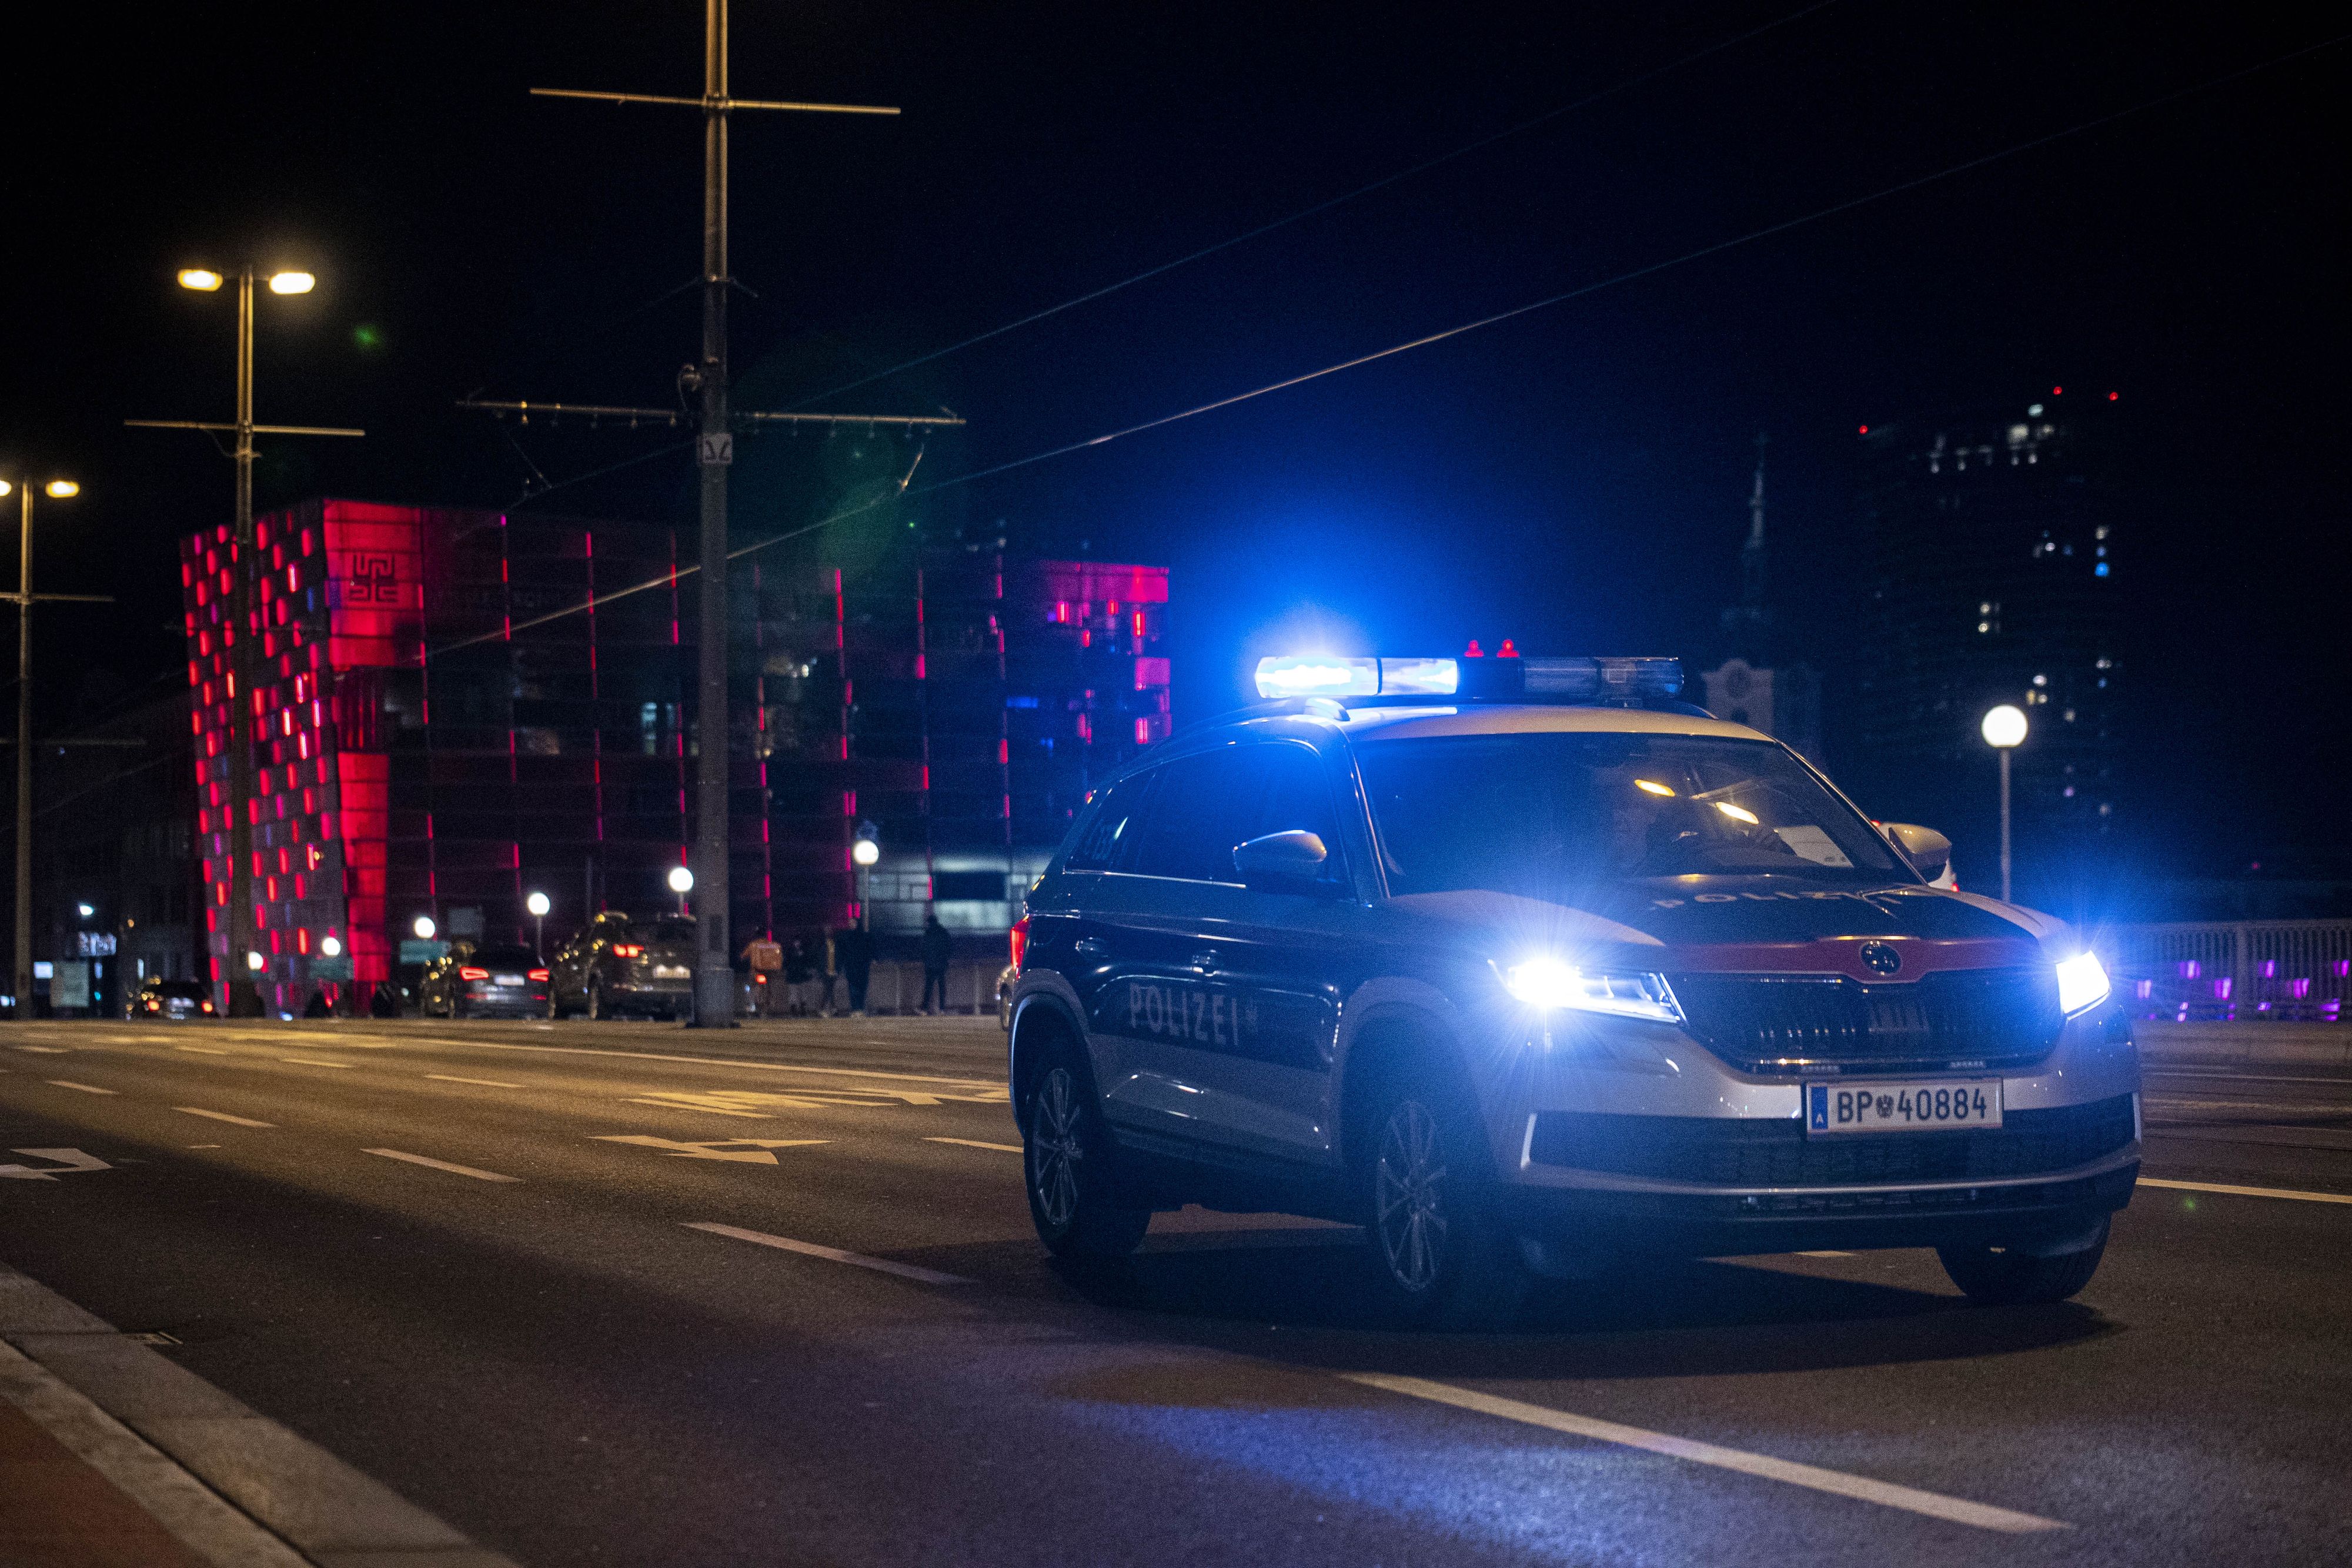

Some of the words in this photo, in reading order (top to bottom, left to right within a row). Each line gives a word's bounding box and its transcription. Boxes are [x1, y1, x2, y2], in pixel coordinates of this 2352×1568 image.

[1130, 982, 1240, 1046] POLIZEI
[1816, 1113, 1825, 1124] A
[1837, 1091, 1873, 1123] BP
[1897, 1088, 1987, 1121] 40884
